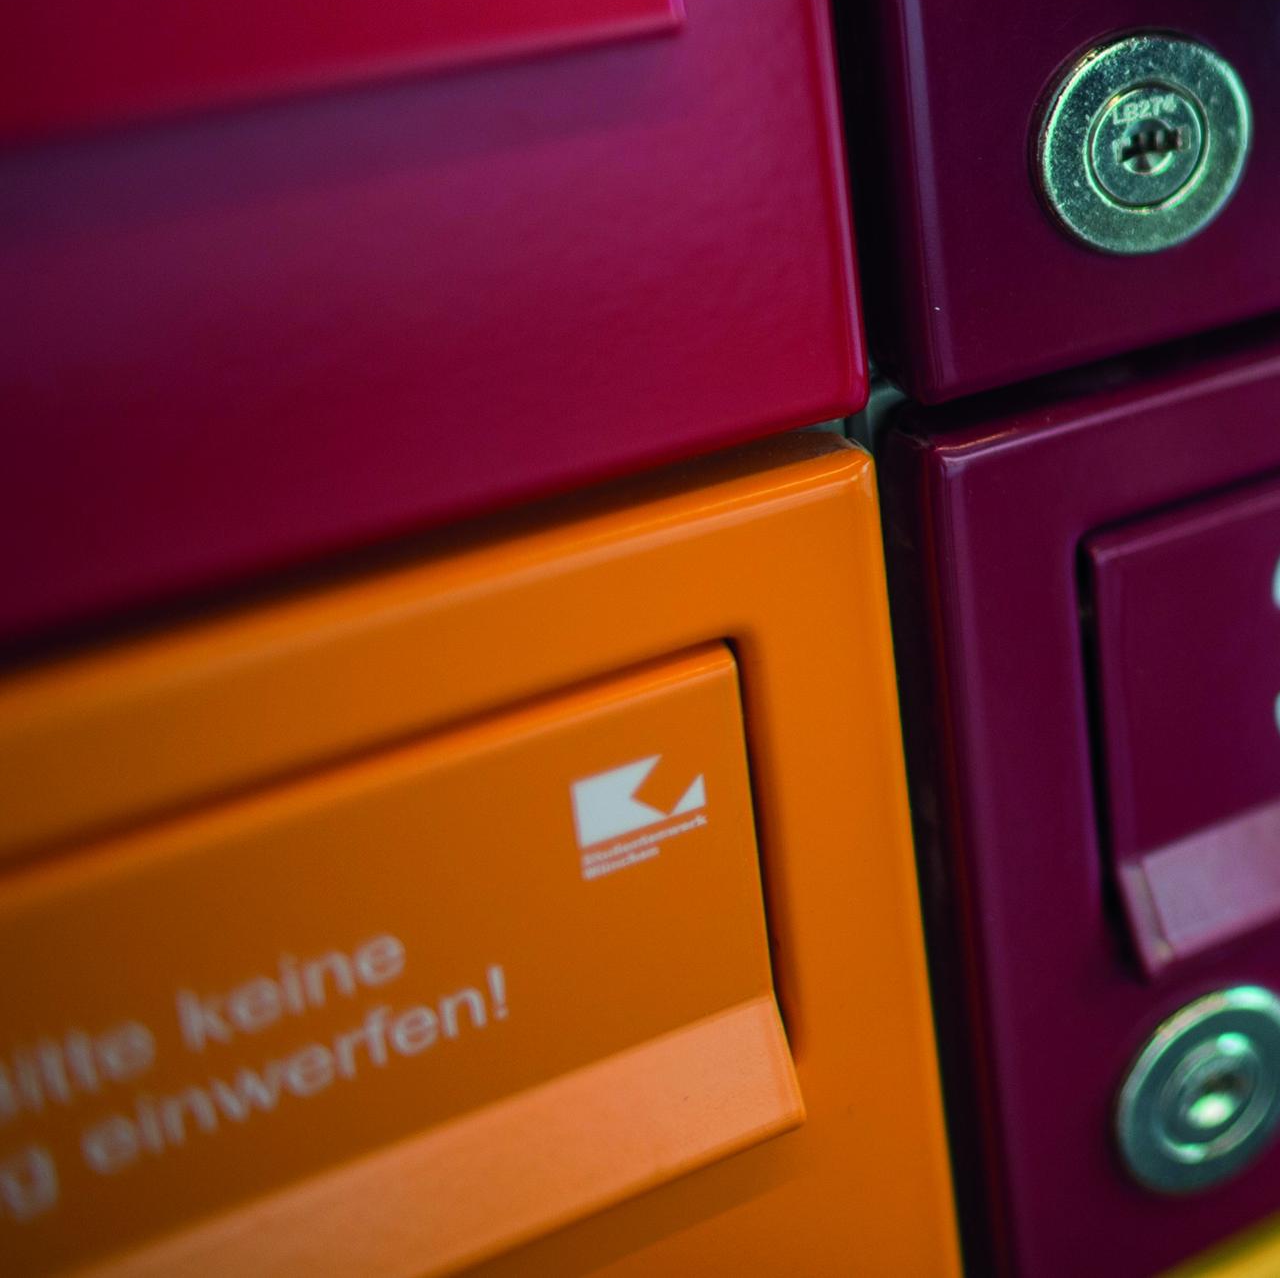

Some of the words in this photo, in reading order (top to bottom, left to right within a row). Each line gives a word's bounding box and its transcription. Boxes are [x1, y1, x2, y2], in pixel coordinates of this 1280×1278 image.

[0, 1021, 156, 1117] itte
[176, 933, 406, 1052] keine
[80, 964, 508, 1175] einwerfen!
